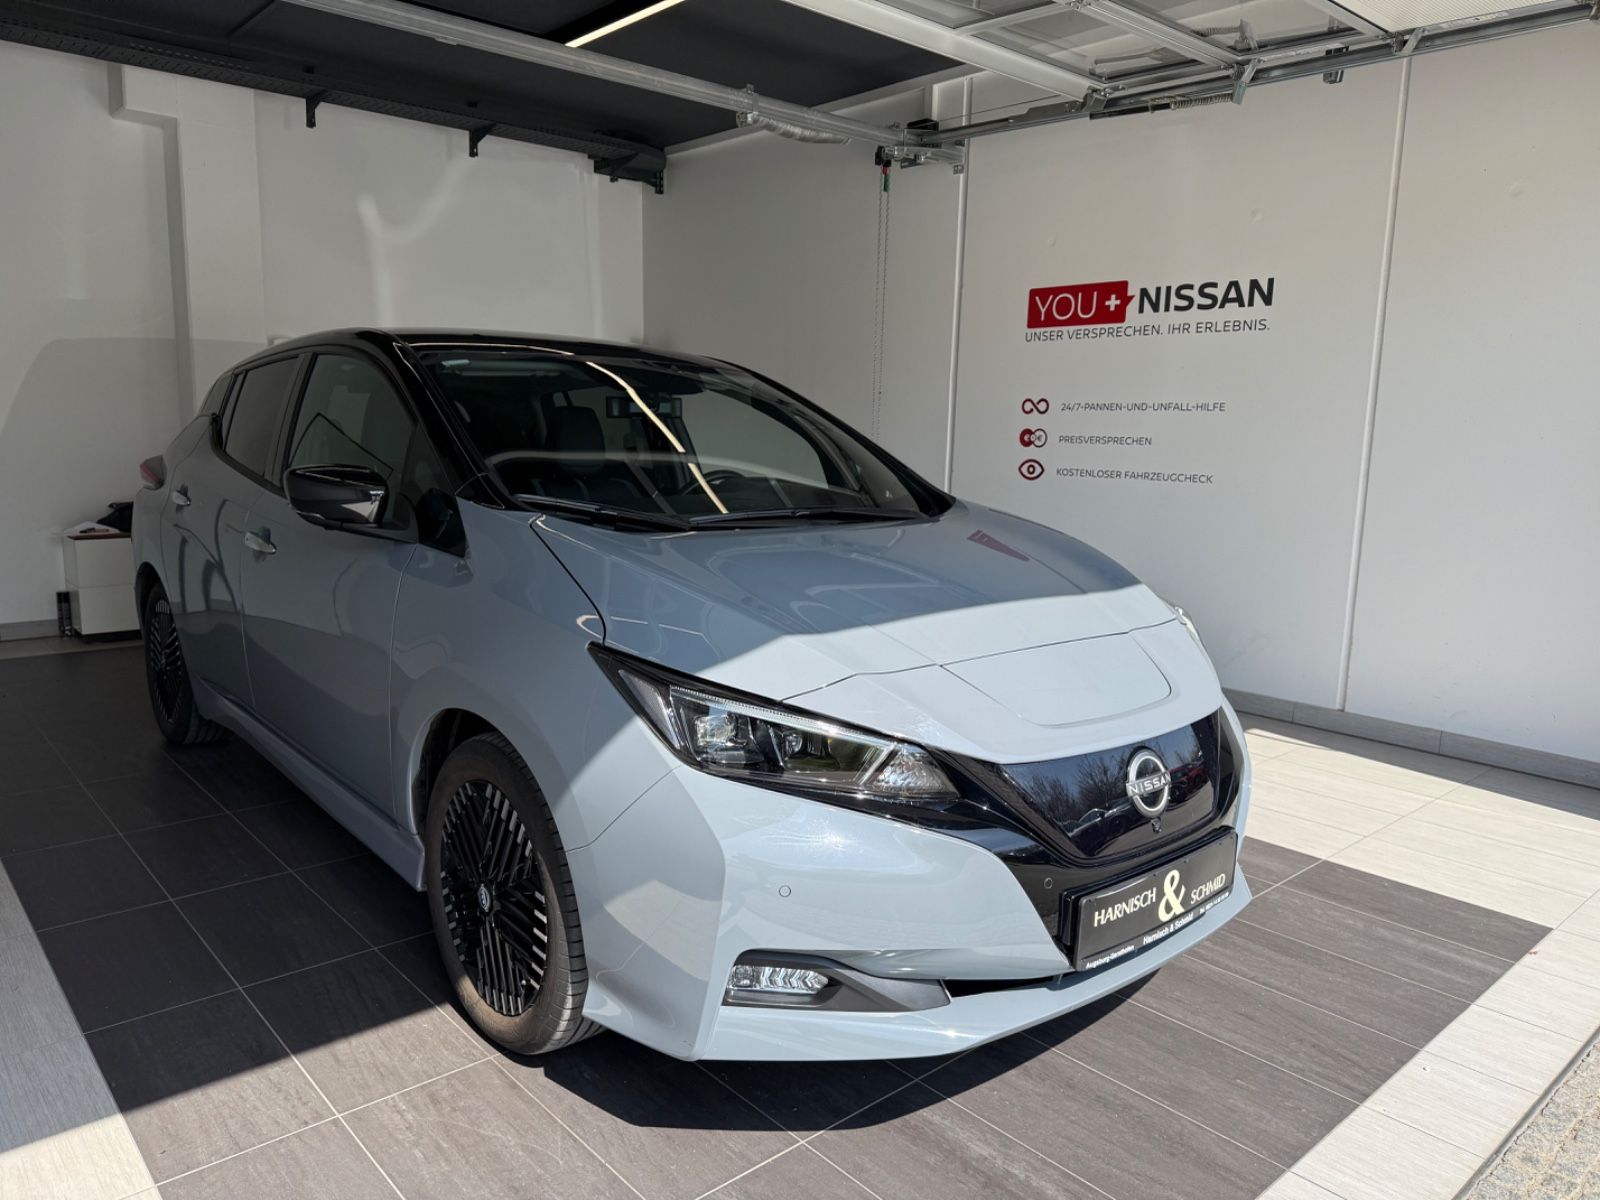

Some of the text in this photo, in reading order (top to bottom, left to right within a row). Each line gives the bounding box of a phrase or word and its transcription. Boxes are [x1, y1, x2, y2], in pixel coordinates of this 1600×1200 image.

[1138, 277, 1275, 314] NISSAN
[1025, 318, 1270, 342] UNSER VERSPRECHEN. IHR ERLEBNIS.
[1060, 402, 1226, 412] 24/7-PANNEN-UND-UNFALL-HILFE
[1058, 435, 1152, 446] PREISVERSPRECHEN
[1056, 468, 1213, 484] KOSTENLOSER FAHRZEUGCHECK
[1126, 771, 1171, 797] NISSAN
[1093, 887, 1157, 927] HARNISCH
[1158, 869, 1186, 922] &
[1190, 873, 1226, 905] SCHMID
[1142, 926, 1169, 945] Harnisch
[1174, 911, 1194, 930] Schmid
